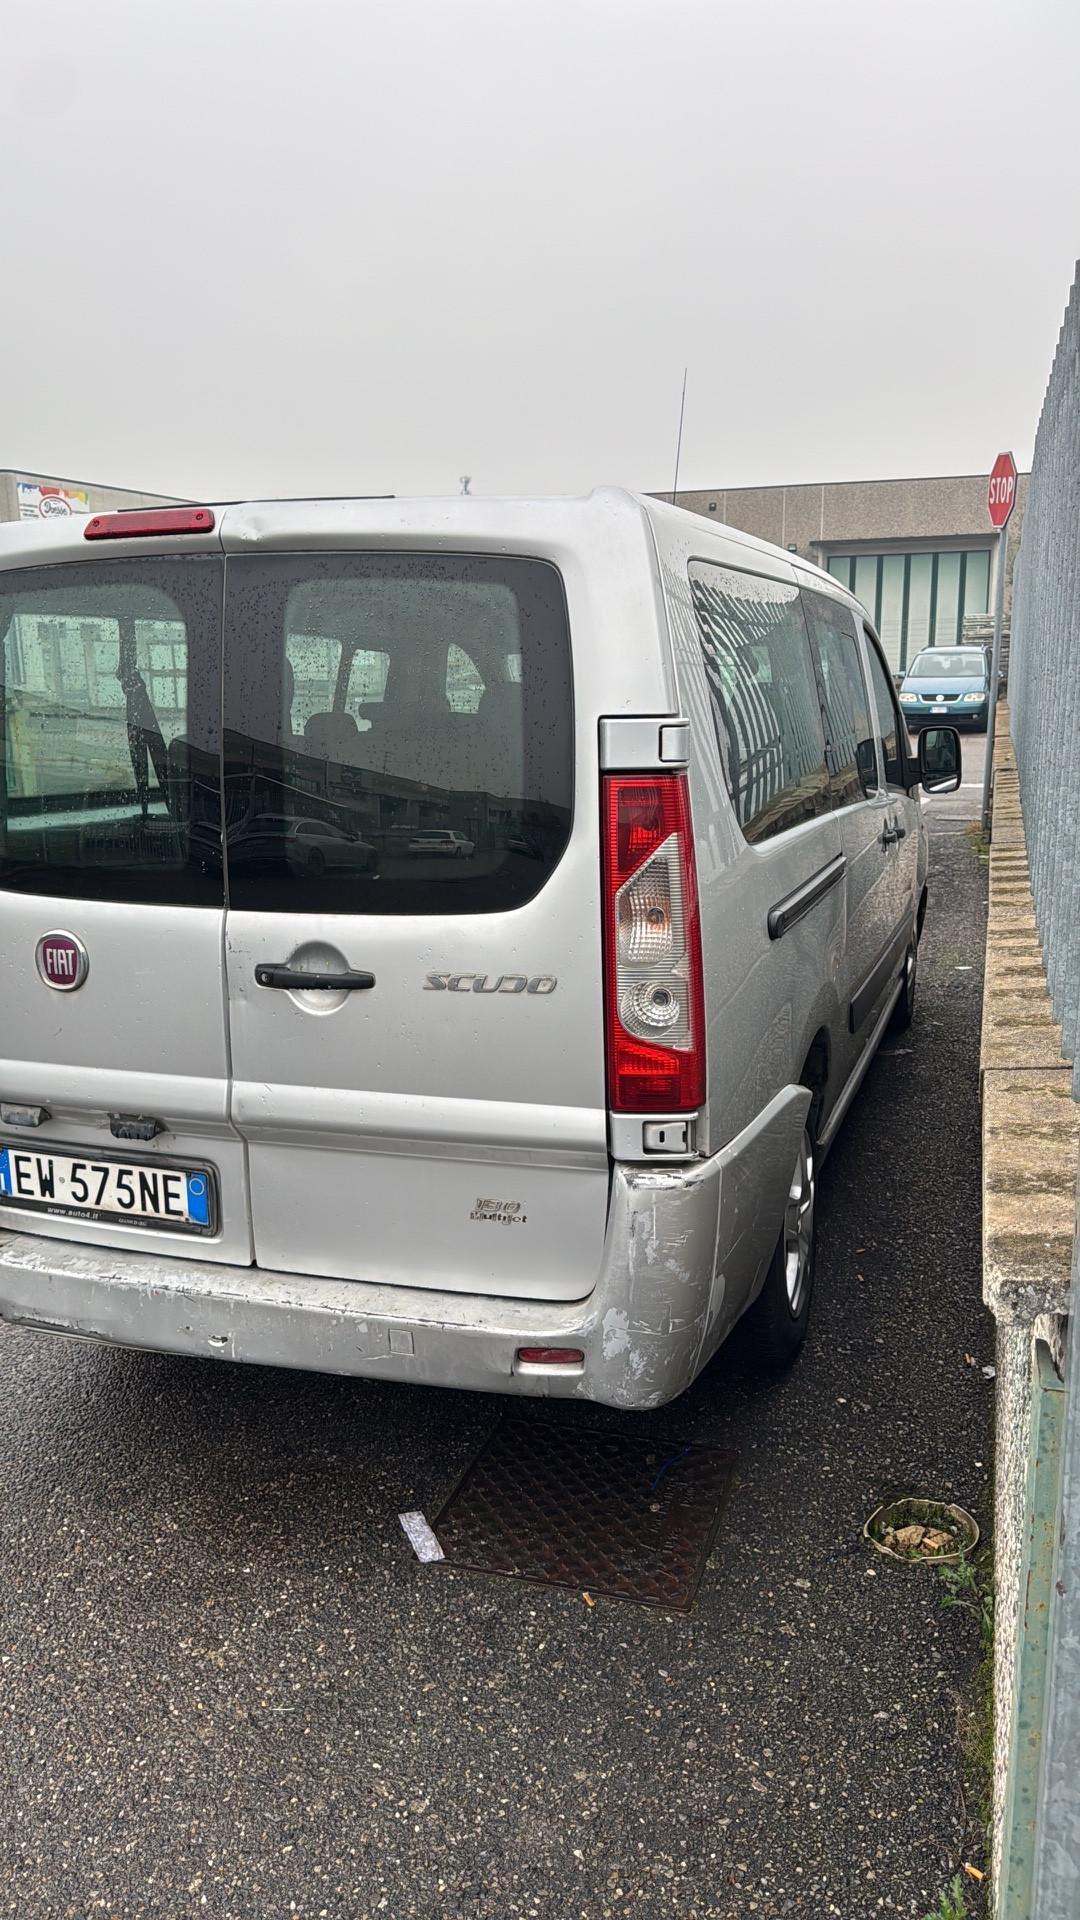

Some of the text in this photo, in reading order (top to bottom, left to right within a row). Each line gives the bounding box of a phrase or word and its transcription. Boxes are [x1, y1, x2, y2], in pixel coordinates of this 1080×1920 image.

[989, 476, 1013, 504] STOP
[46, 948, 75, 976] FIAT
[423, 971, 557, 994] SCUDO
[14, 1155, 184, 1217] EW 575NE
[47, 1206, 99, 1220] www.auto4.it
